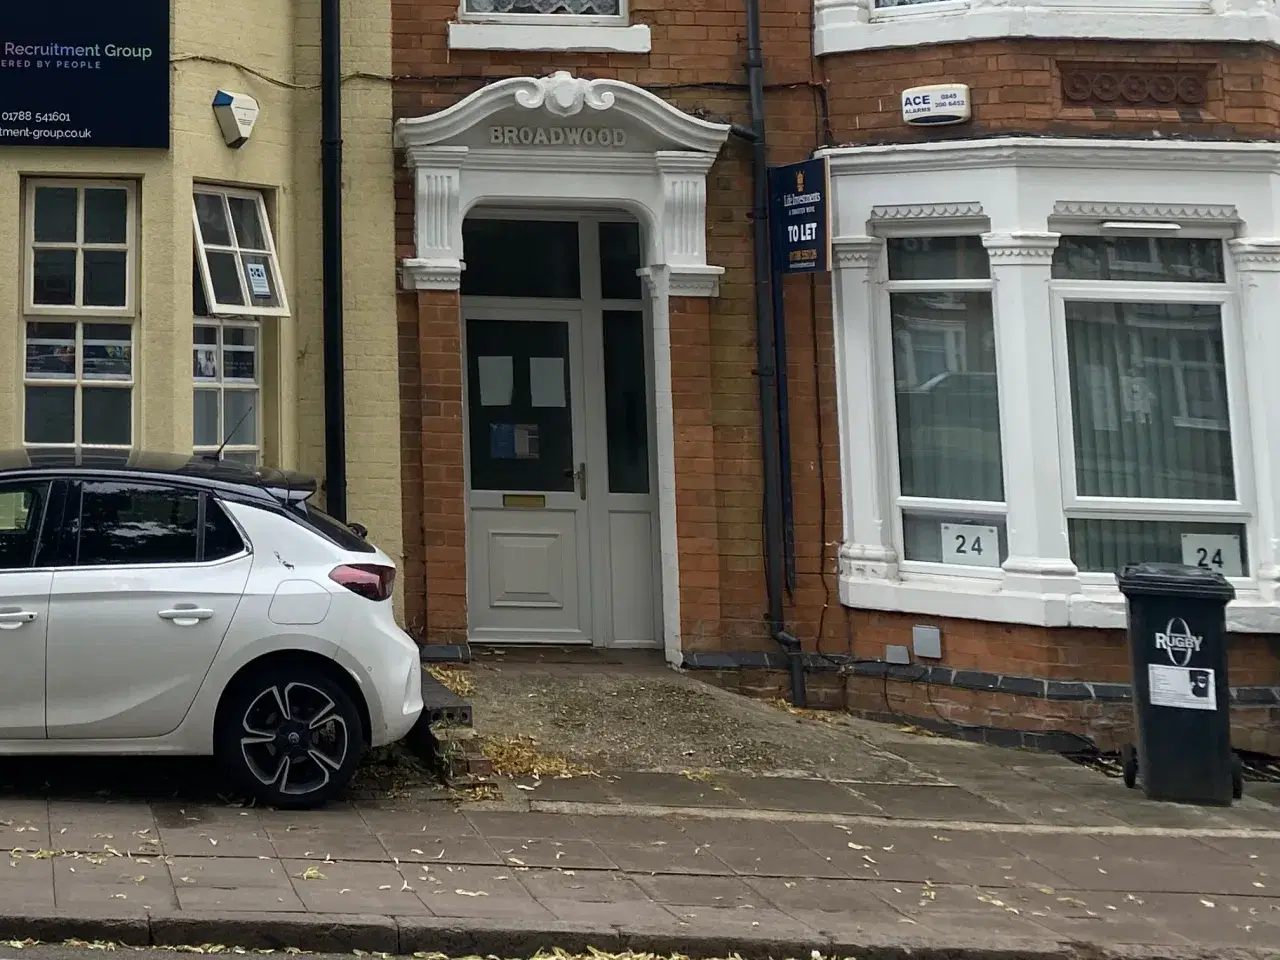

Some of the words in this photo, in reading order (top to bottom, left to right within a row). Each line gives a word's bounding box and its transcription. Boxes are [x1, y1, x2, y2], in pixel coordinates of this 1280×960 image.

[4, 42, 101, 57] Recruitment
[104, 43, 153, 61] Group
[36, 60, 51, 68] BY
[56, 60, 102, 69] PEOPLE
[904, 94, 931, 107] ACE
[904, 106, 931, 114] ALARMS
[1, 110, 32, 122] 01788
[35, 111, 71, 123] 541601
[489, 125, 628, 147] BROADWOOD
[788, 224, 799, 242] TO
[800, 222, 818, 241] LET
[955, 534, 984, 556] 24
[1196, 547, 1224, 568] 24
[1154, 632, 1203, 652] RUGBY
